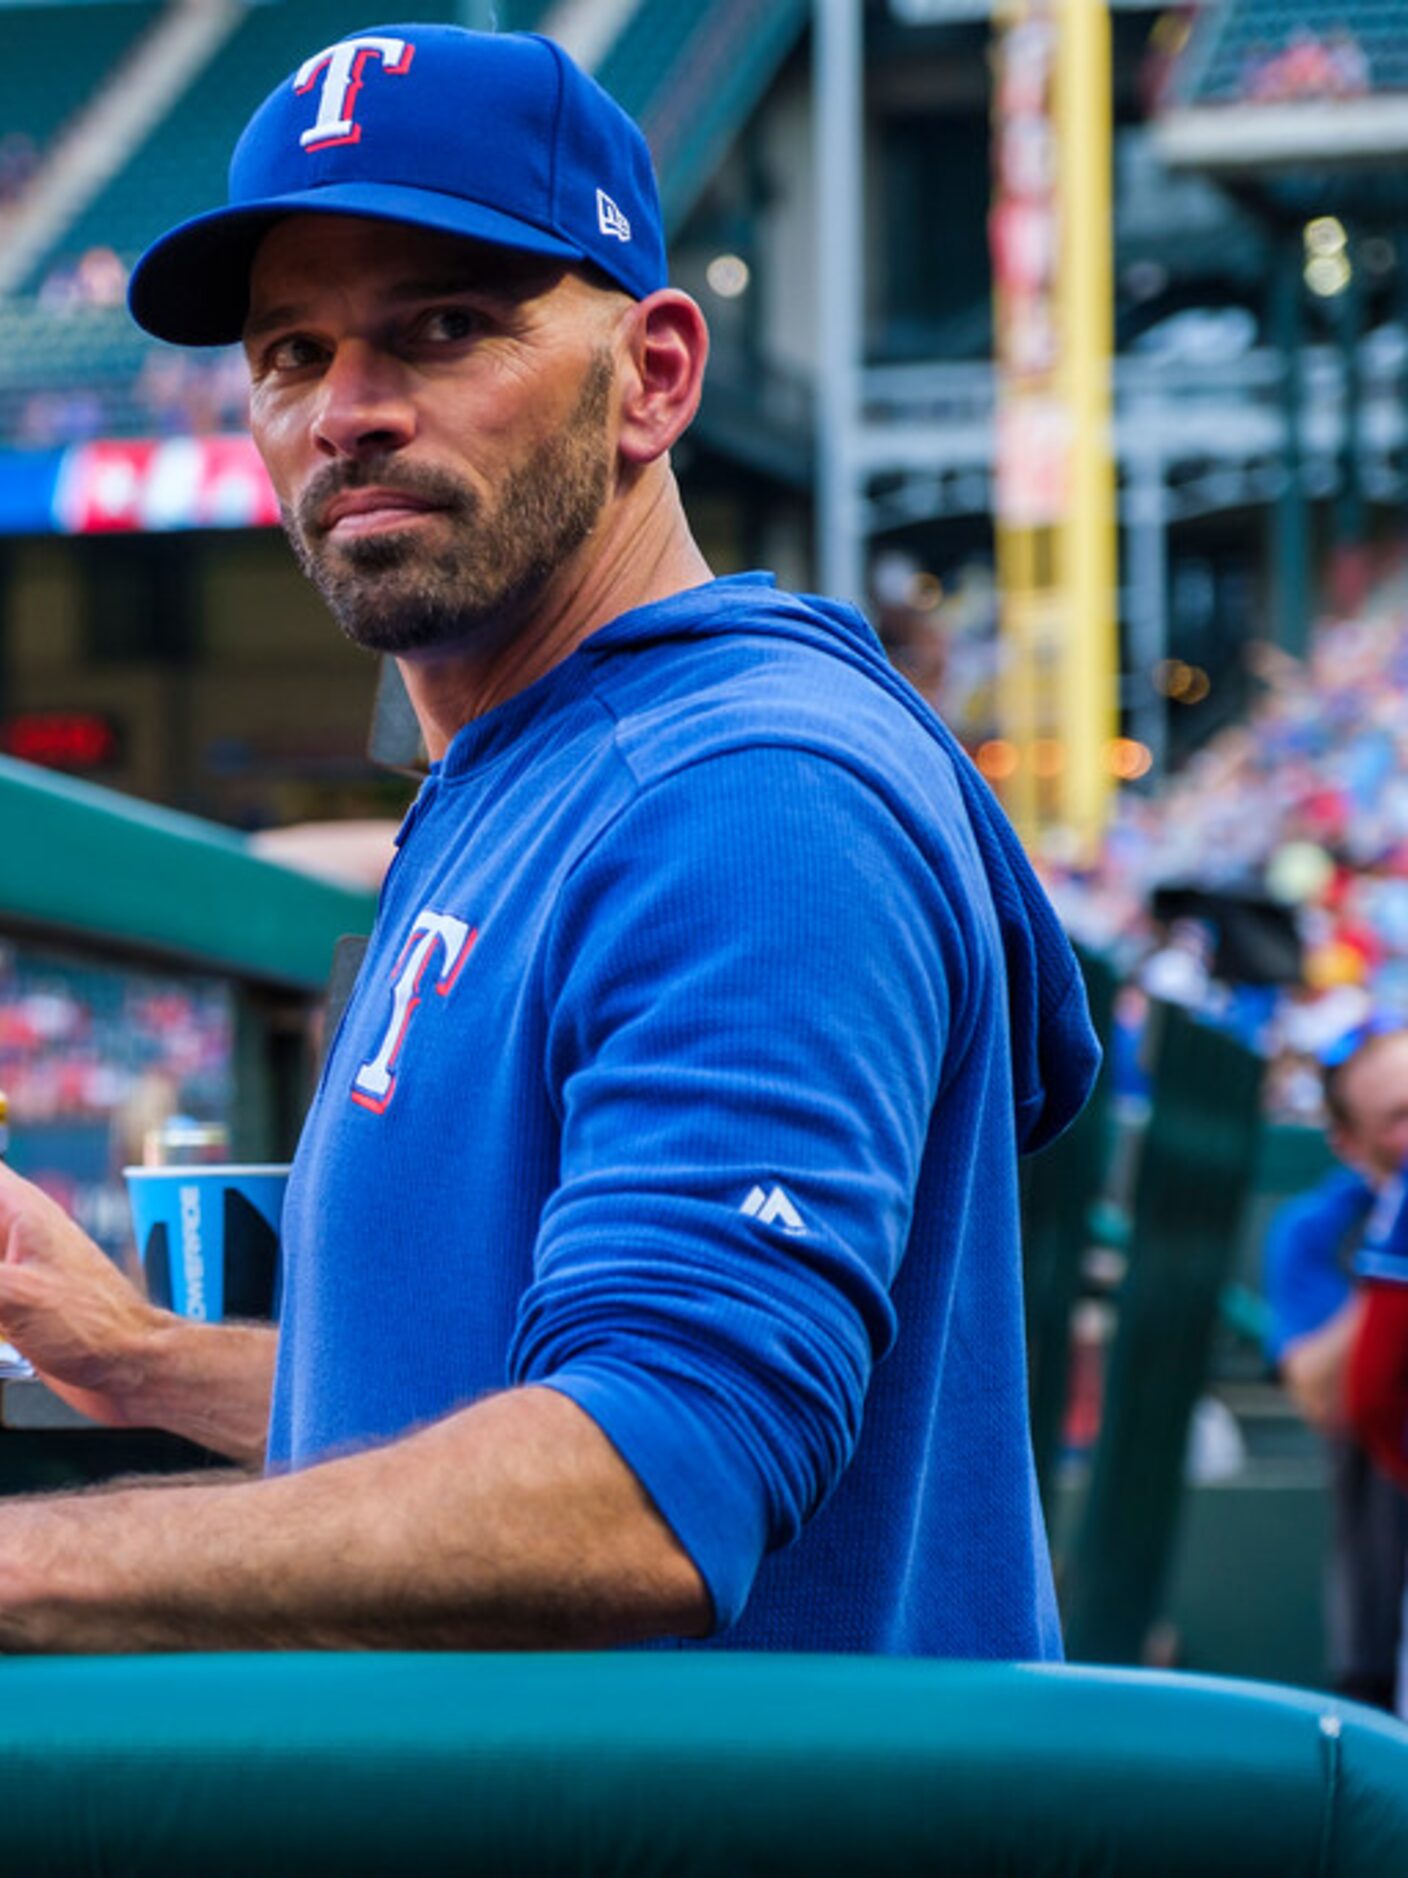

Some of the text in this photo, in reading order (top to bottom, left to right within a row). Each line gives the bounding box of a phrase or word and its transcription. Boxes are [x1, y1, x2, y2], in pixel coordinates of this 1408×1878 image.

[291, 36, 416, 153] T
[351, 908, 478, 1115] T
[179, 1186, 207, 1320] OWERADE
